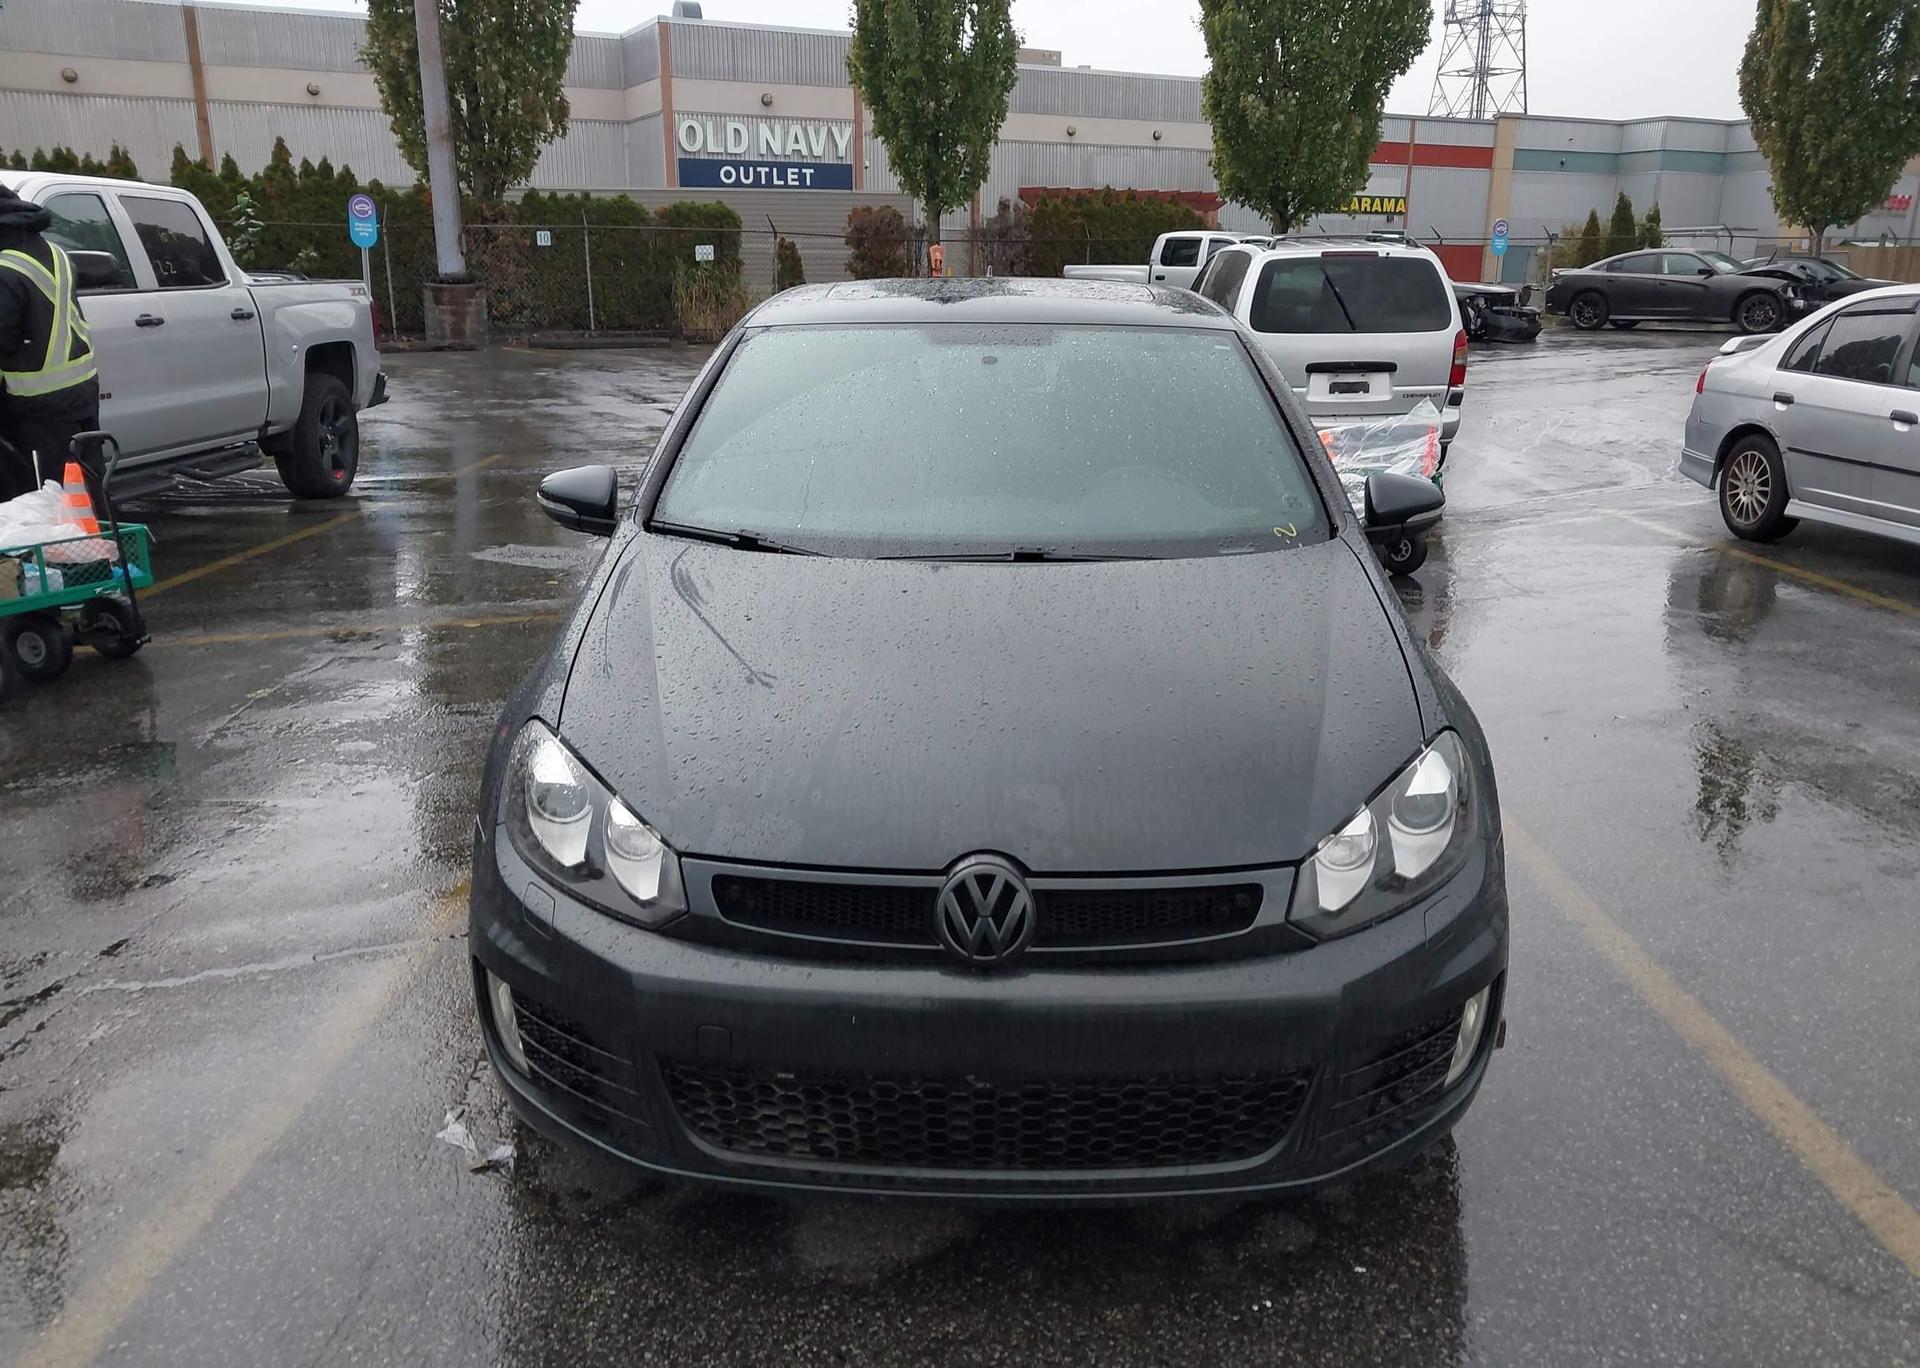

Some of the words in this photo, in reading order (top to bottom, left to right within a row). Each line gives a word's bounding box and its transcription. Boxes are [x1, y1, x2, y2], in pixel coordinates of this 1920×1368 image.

[678, 118, 749, 154] OLD
[758, 122, 853, 158] NAVY
[719, 165, 815, 187] OUTLET
[539, 232, 549, 244] 10
